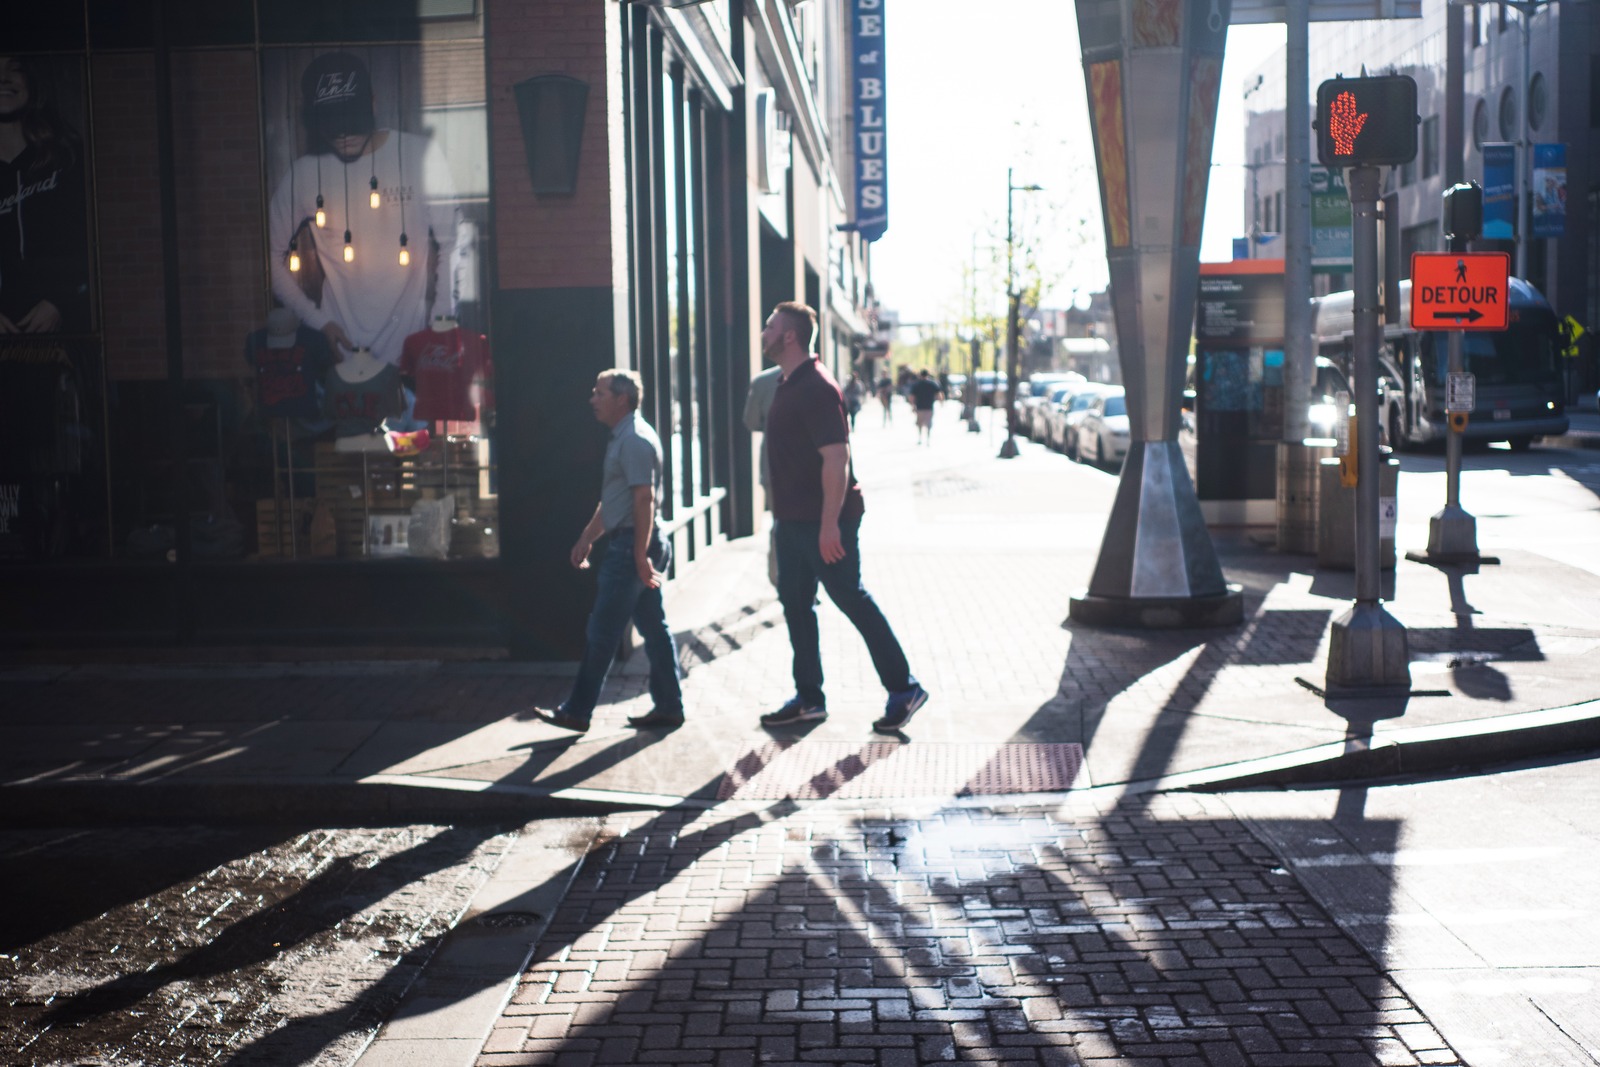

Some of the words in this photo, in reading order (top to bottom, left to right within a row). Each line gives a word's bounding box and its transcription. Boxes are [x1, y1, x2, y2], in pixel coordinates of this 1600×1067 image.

[859, 50, 878, 64] of
[859, 78, 884, 209] BLUES
[1421, 286, 1497, 304] DETOUR
